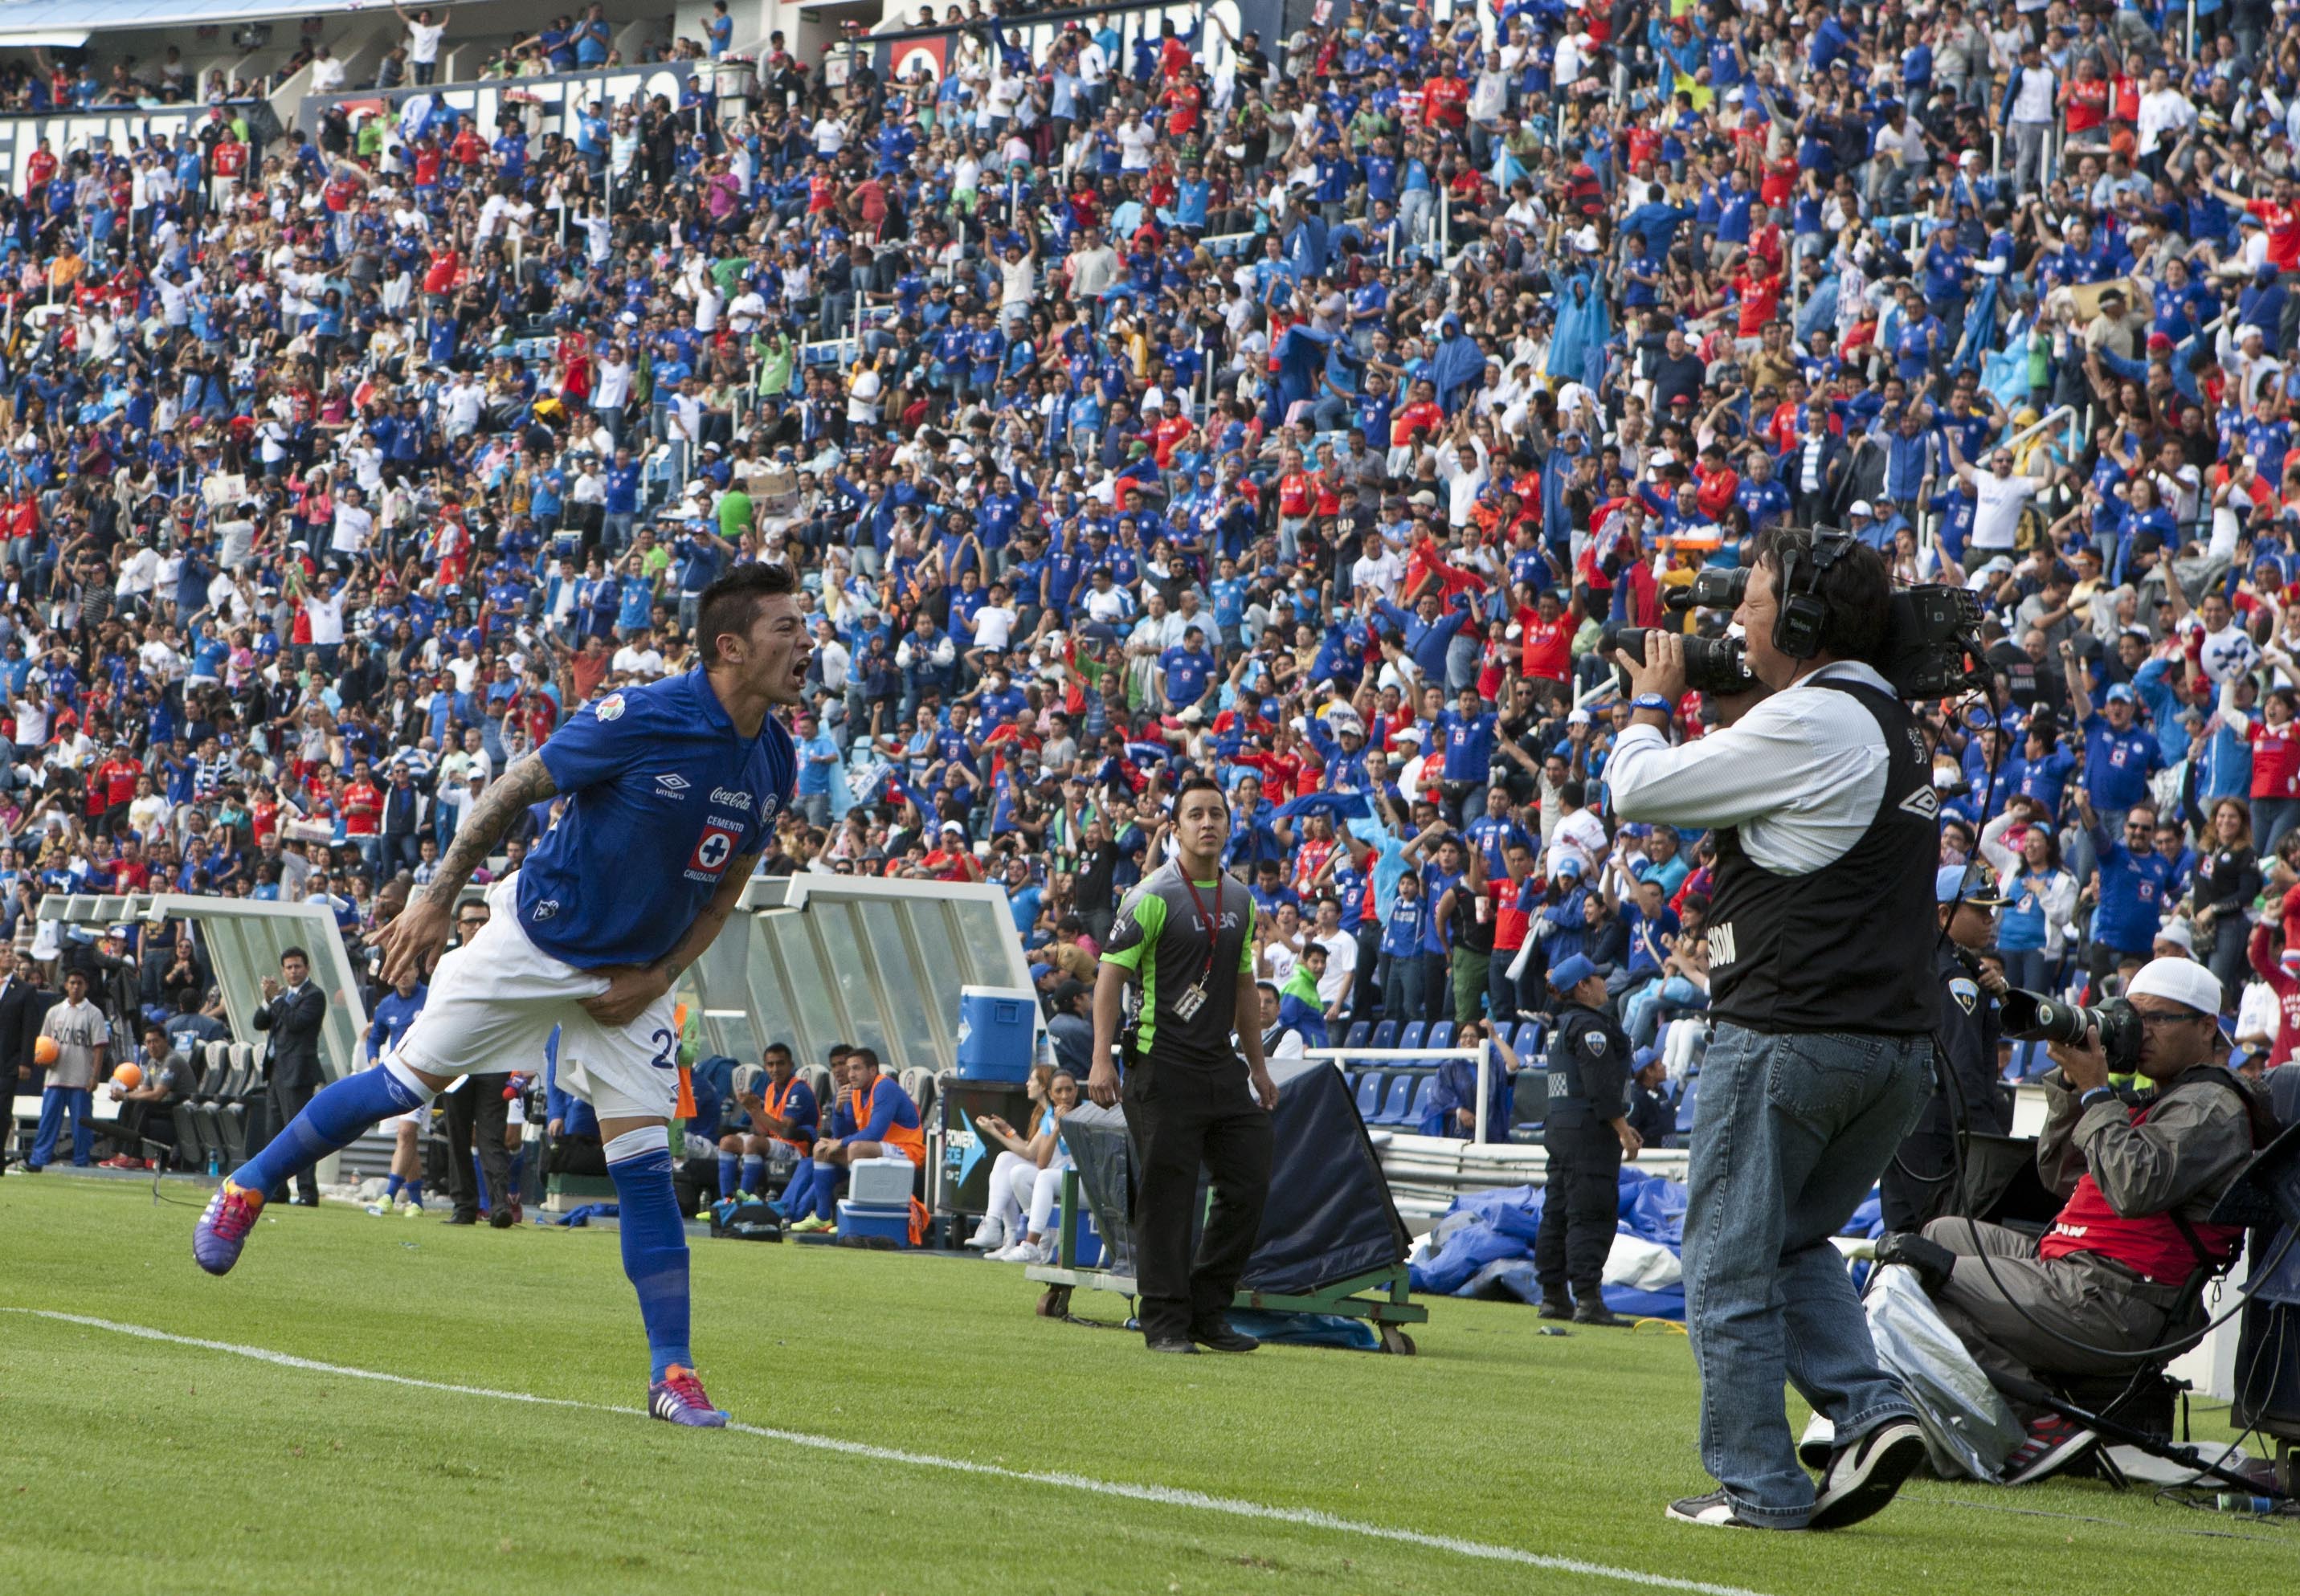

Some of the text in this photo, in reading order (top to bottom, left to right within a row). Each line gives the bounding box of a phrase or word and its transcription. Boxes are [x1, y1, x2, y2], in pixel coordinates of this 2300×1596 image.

[1790, 618, 1812, 633] Telex
[1742, 663, 1752, 678] 5
[656, 788, 684, 800] umbro
[707, 815, 744, 832] CEMENTO
[946, 1129, 976, 1149] POWER
